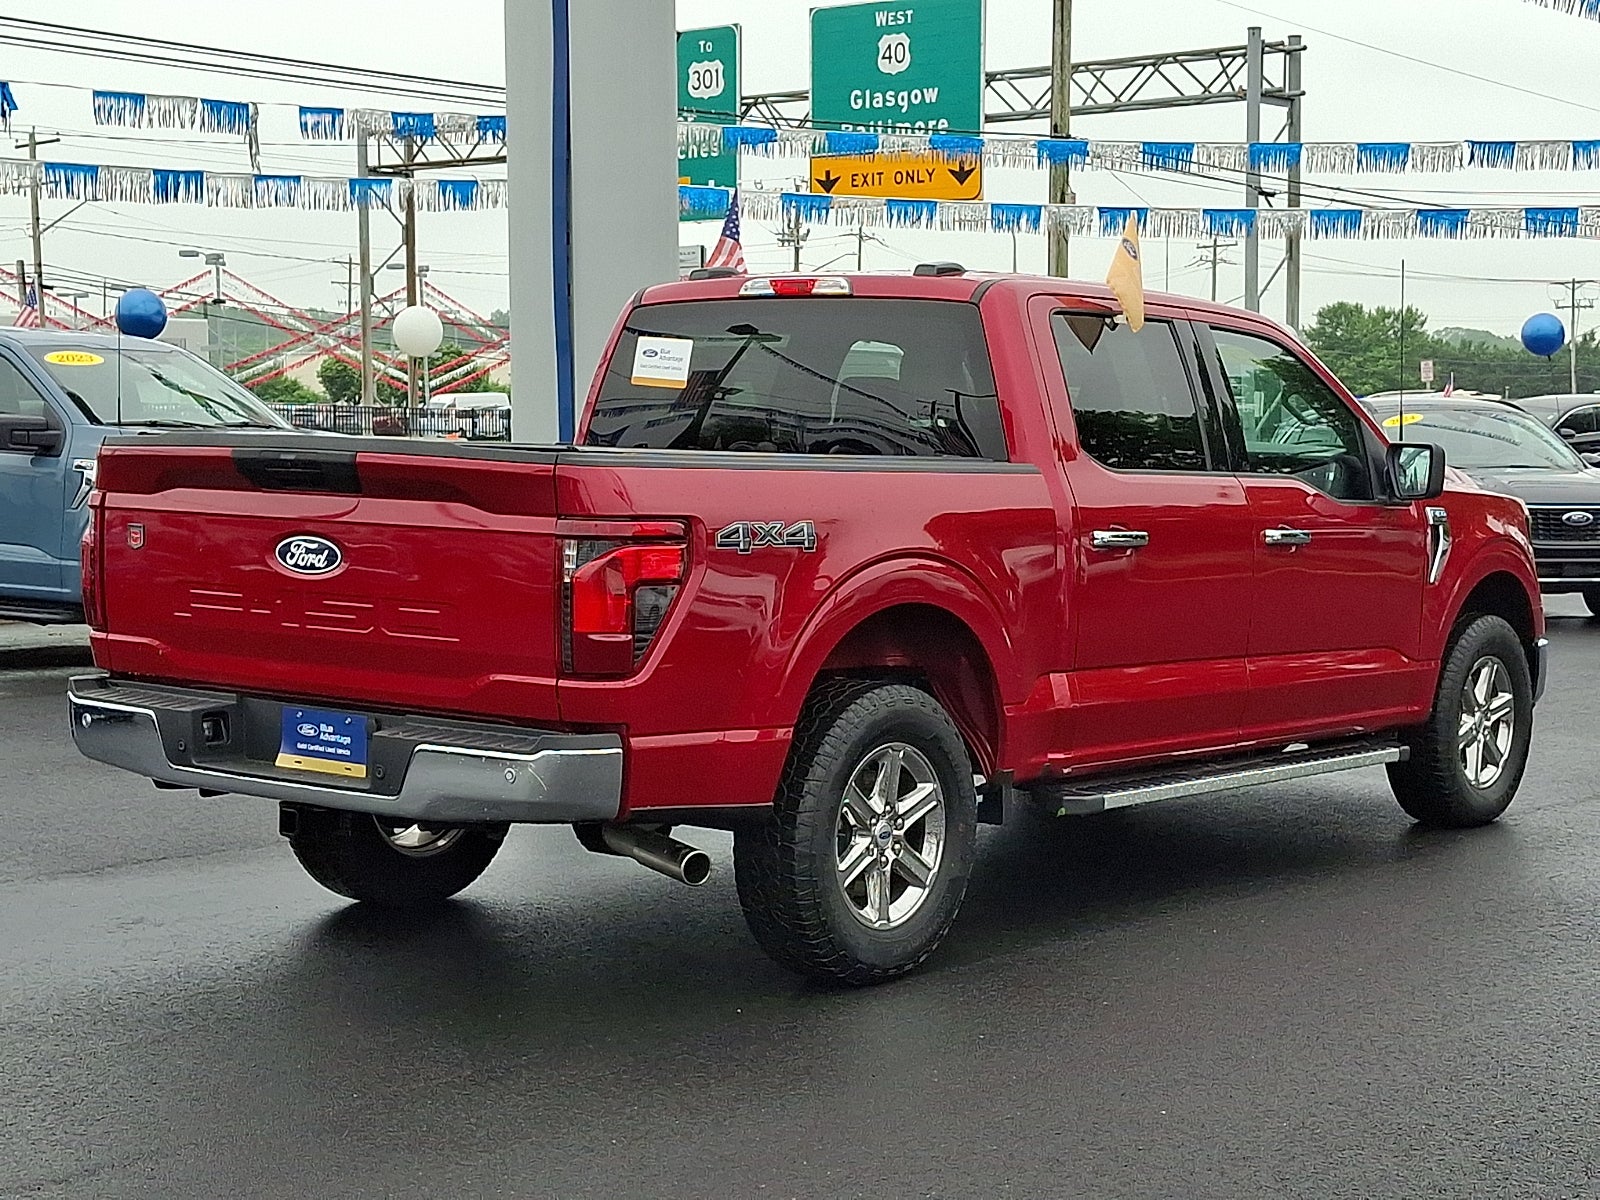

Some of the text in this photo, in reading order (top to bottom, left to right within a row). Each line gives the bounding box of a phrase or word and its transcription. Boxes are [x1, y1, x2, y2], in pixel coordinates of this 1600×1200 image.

[875, 9, 914, 27] WEST
[881, 42, 906, 65] 40
[691, 68, 720, 91] 301
[850, 87, 939, 113] Glasgow
[851, 168, 936, 188] EXIT ONLY
[286, 541, 330, 568] Ford
